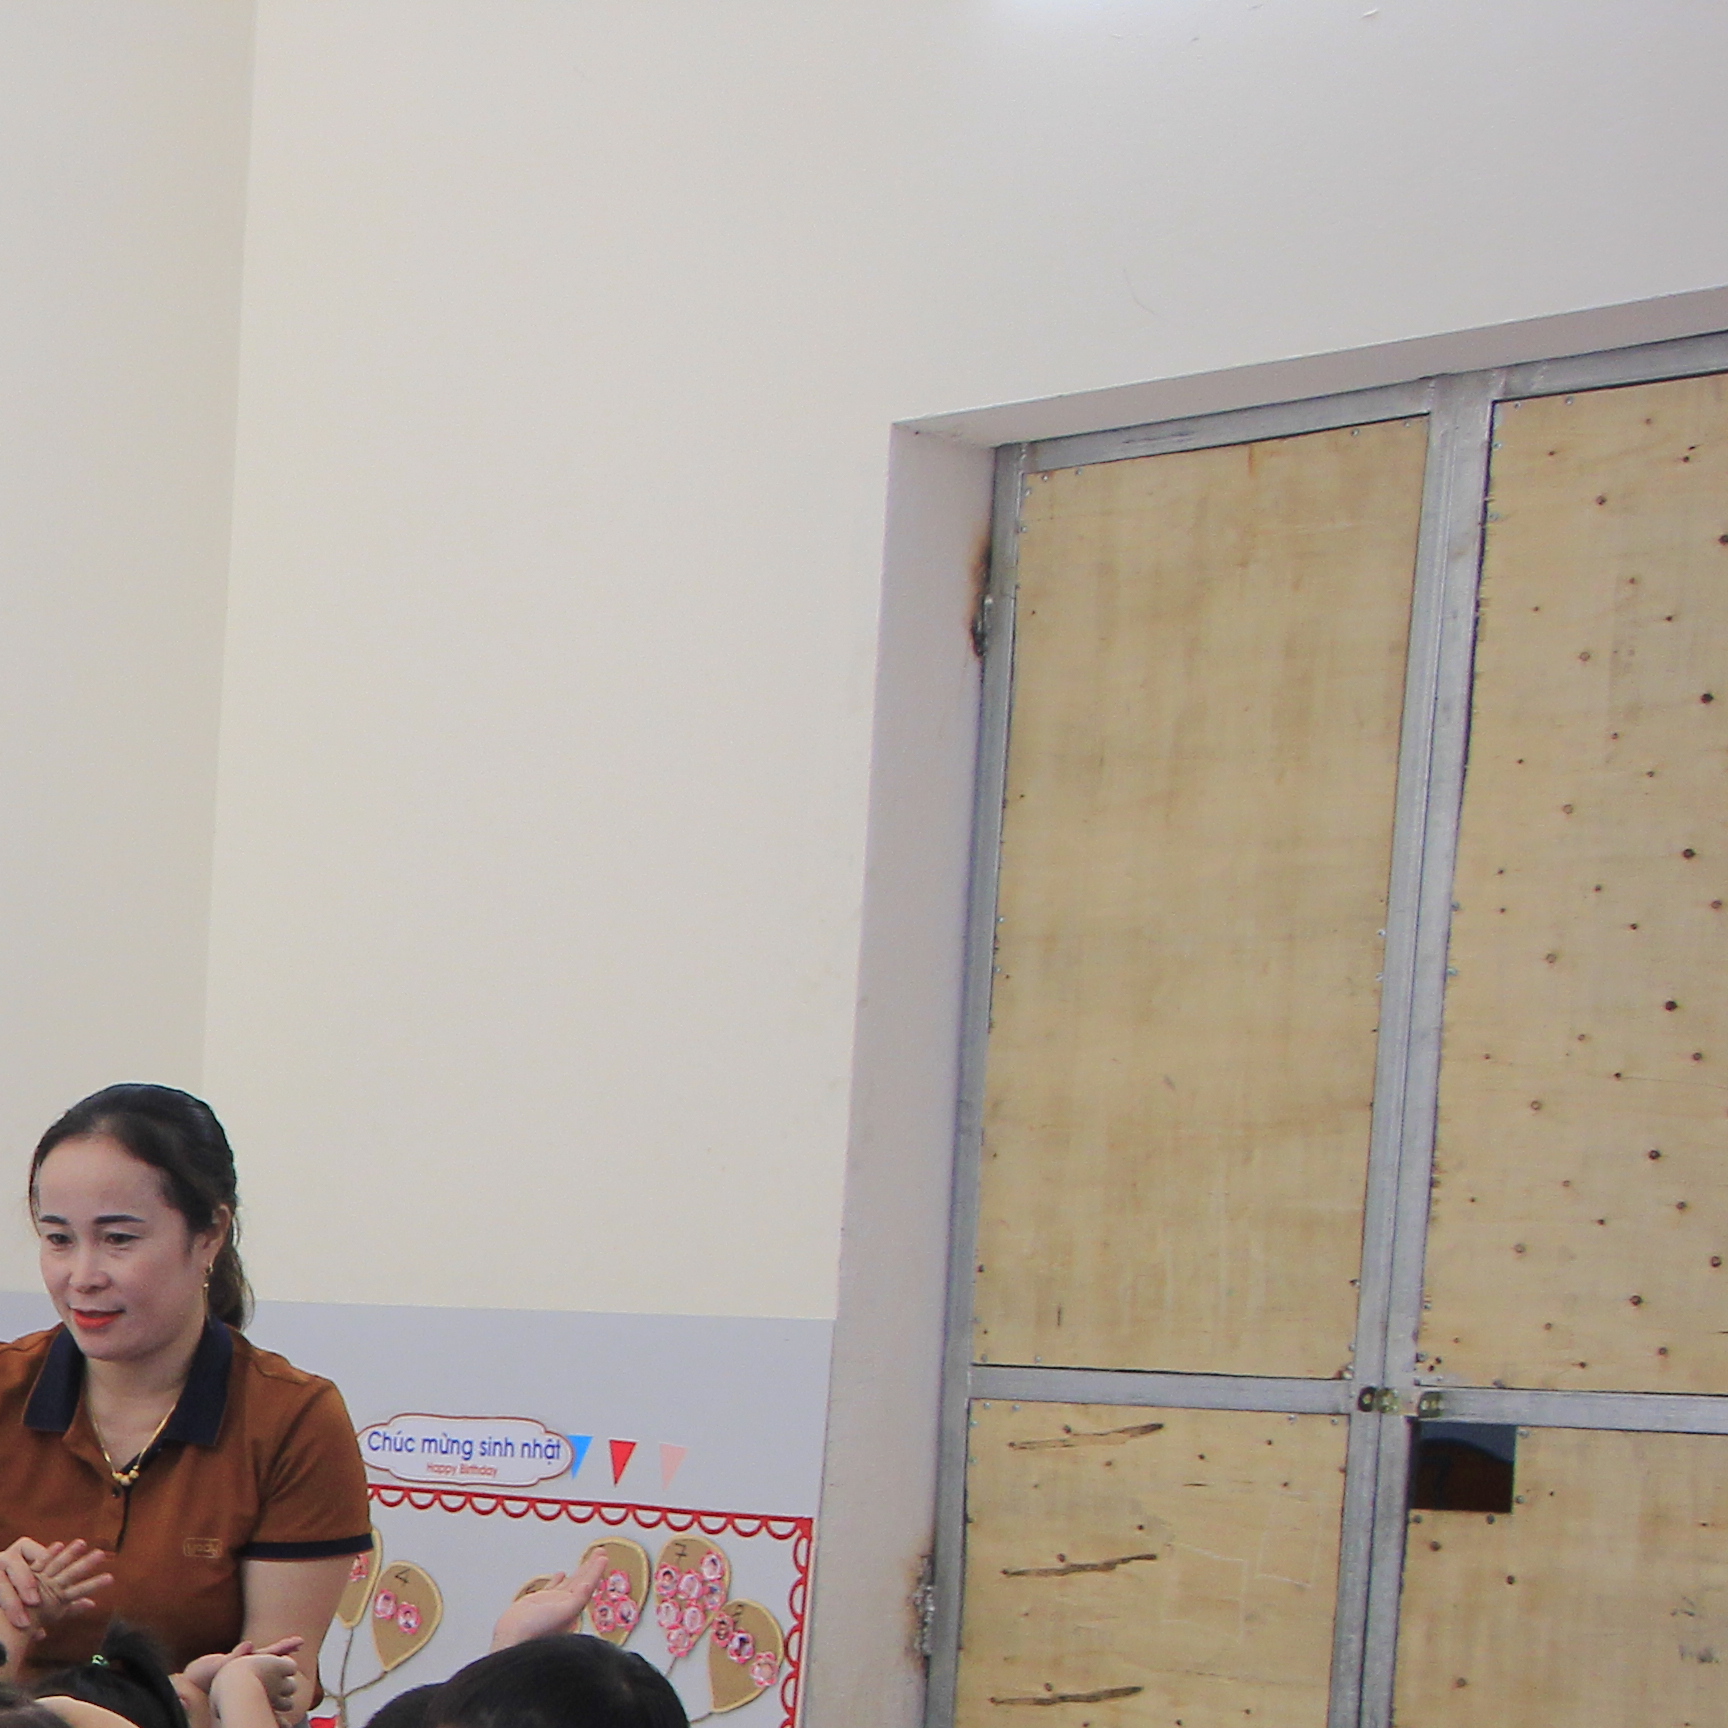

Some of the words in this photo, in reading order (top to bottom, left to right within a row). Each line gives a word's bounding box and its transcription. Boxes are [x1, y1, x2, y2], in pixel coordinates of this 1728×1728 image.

[367, 1431, 415, 1453] Chúc
[421, 1433, 474, 1461] mừng
[479, 1437, 515, 1458] sinh
[520, 1438, 561, 1465] nhật
[426, 1462, 457, 1477] Happy
[459, 1463, 498, 1478] Birthday
